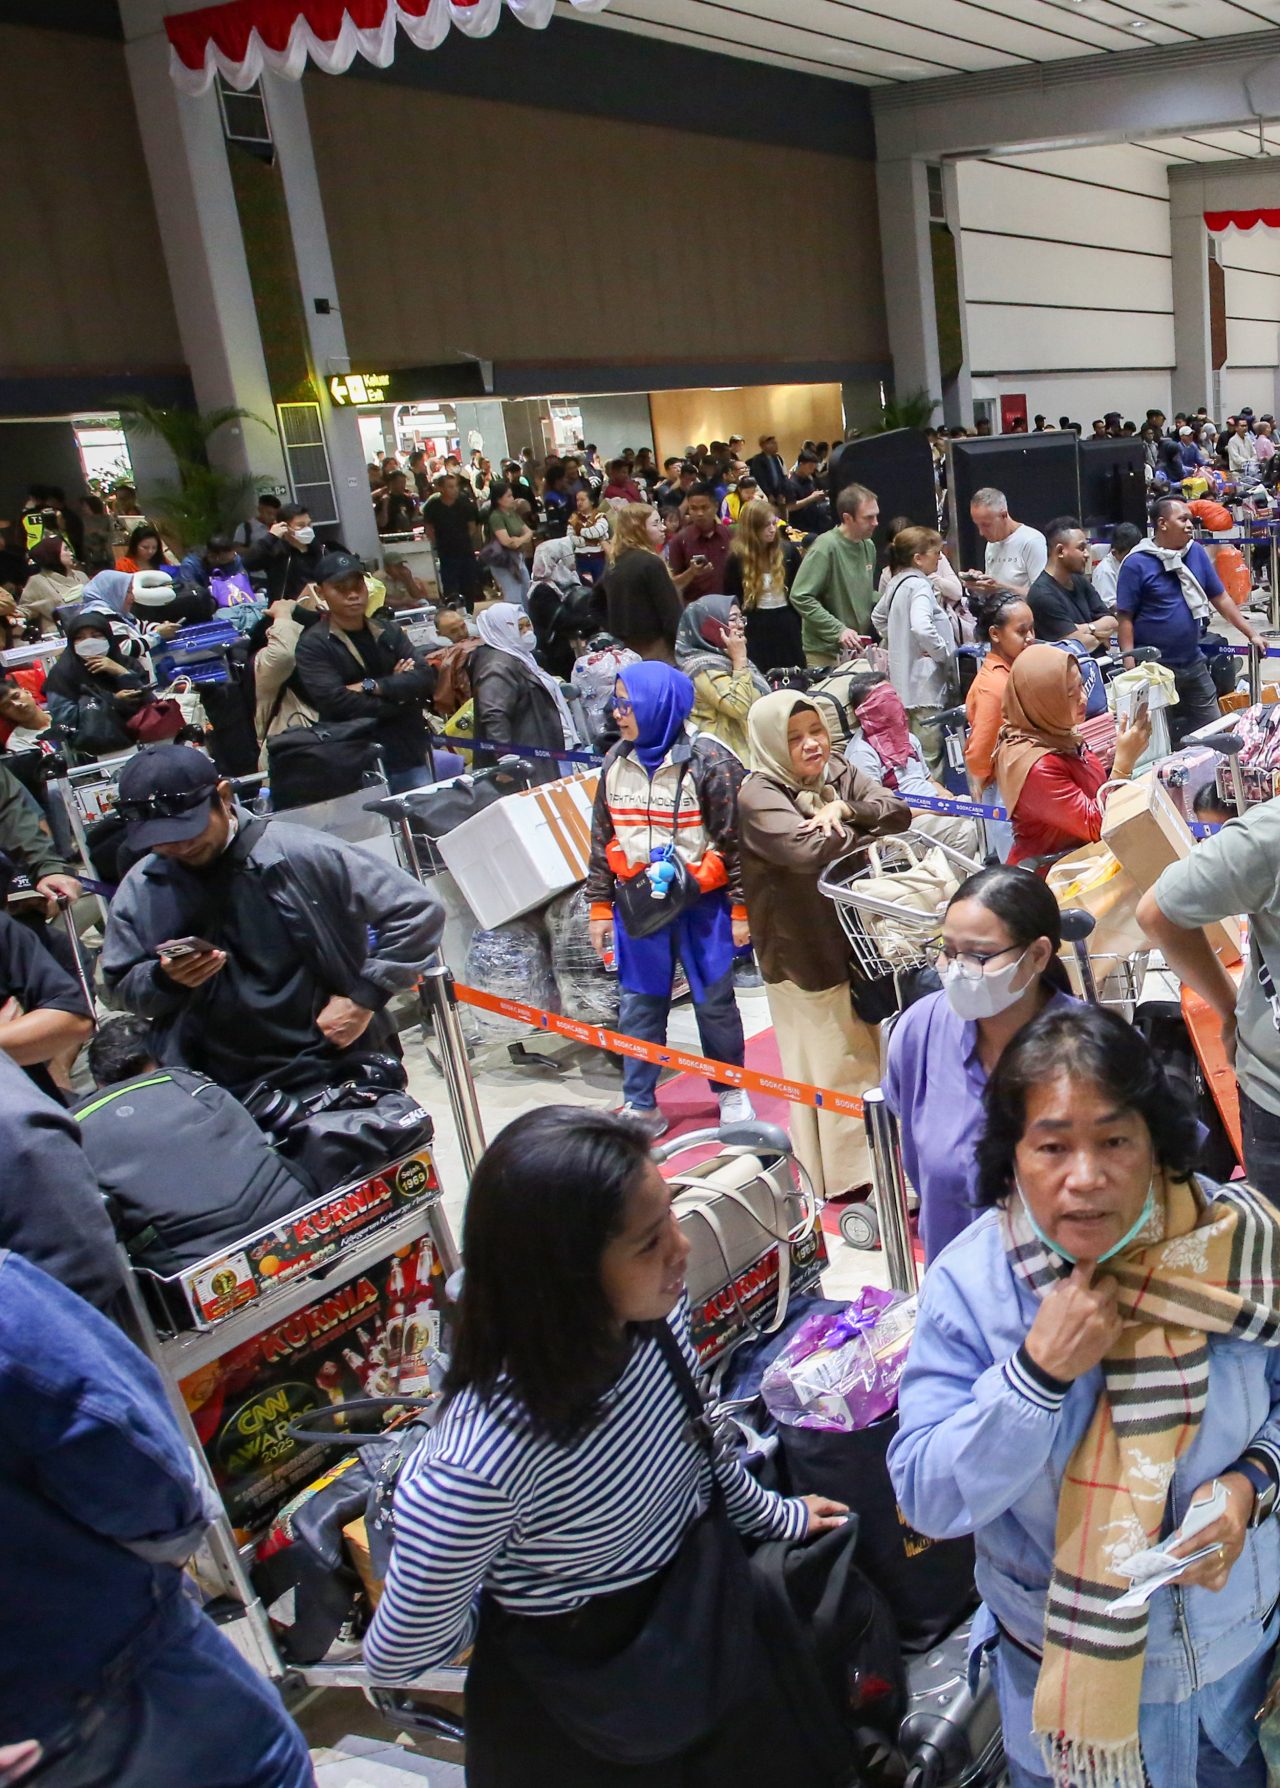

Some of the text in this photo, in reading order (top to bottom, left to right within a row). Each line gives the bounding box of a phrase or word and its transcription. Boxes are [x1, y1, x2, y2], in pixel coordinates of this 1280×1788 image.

[500, 1002, 532, 1017] BOOKCABIN
[556, 1020, 589, 1036] BOOKCABIN
[613, 1038, 648, 1054] BOOKCABIN
[678, 1056, 716, 1073] BOOKCABIN
[760, 1078, 800, 1095] BOOKCABIN
[400, 1165, 421, 1179] Sejak
[401, 1173, 426, 1191] 1969
[293, 1177, 392, 1245] KURNIA
[261, 1276, 378, 1363] KURNIA
[237, 1389, 290, 1436] CNN
[261, 1439, 295, 1465] 2025
